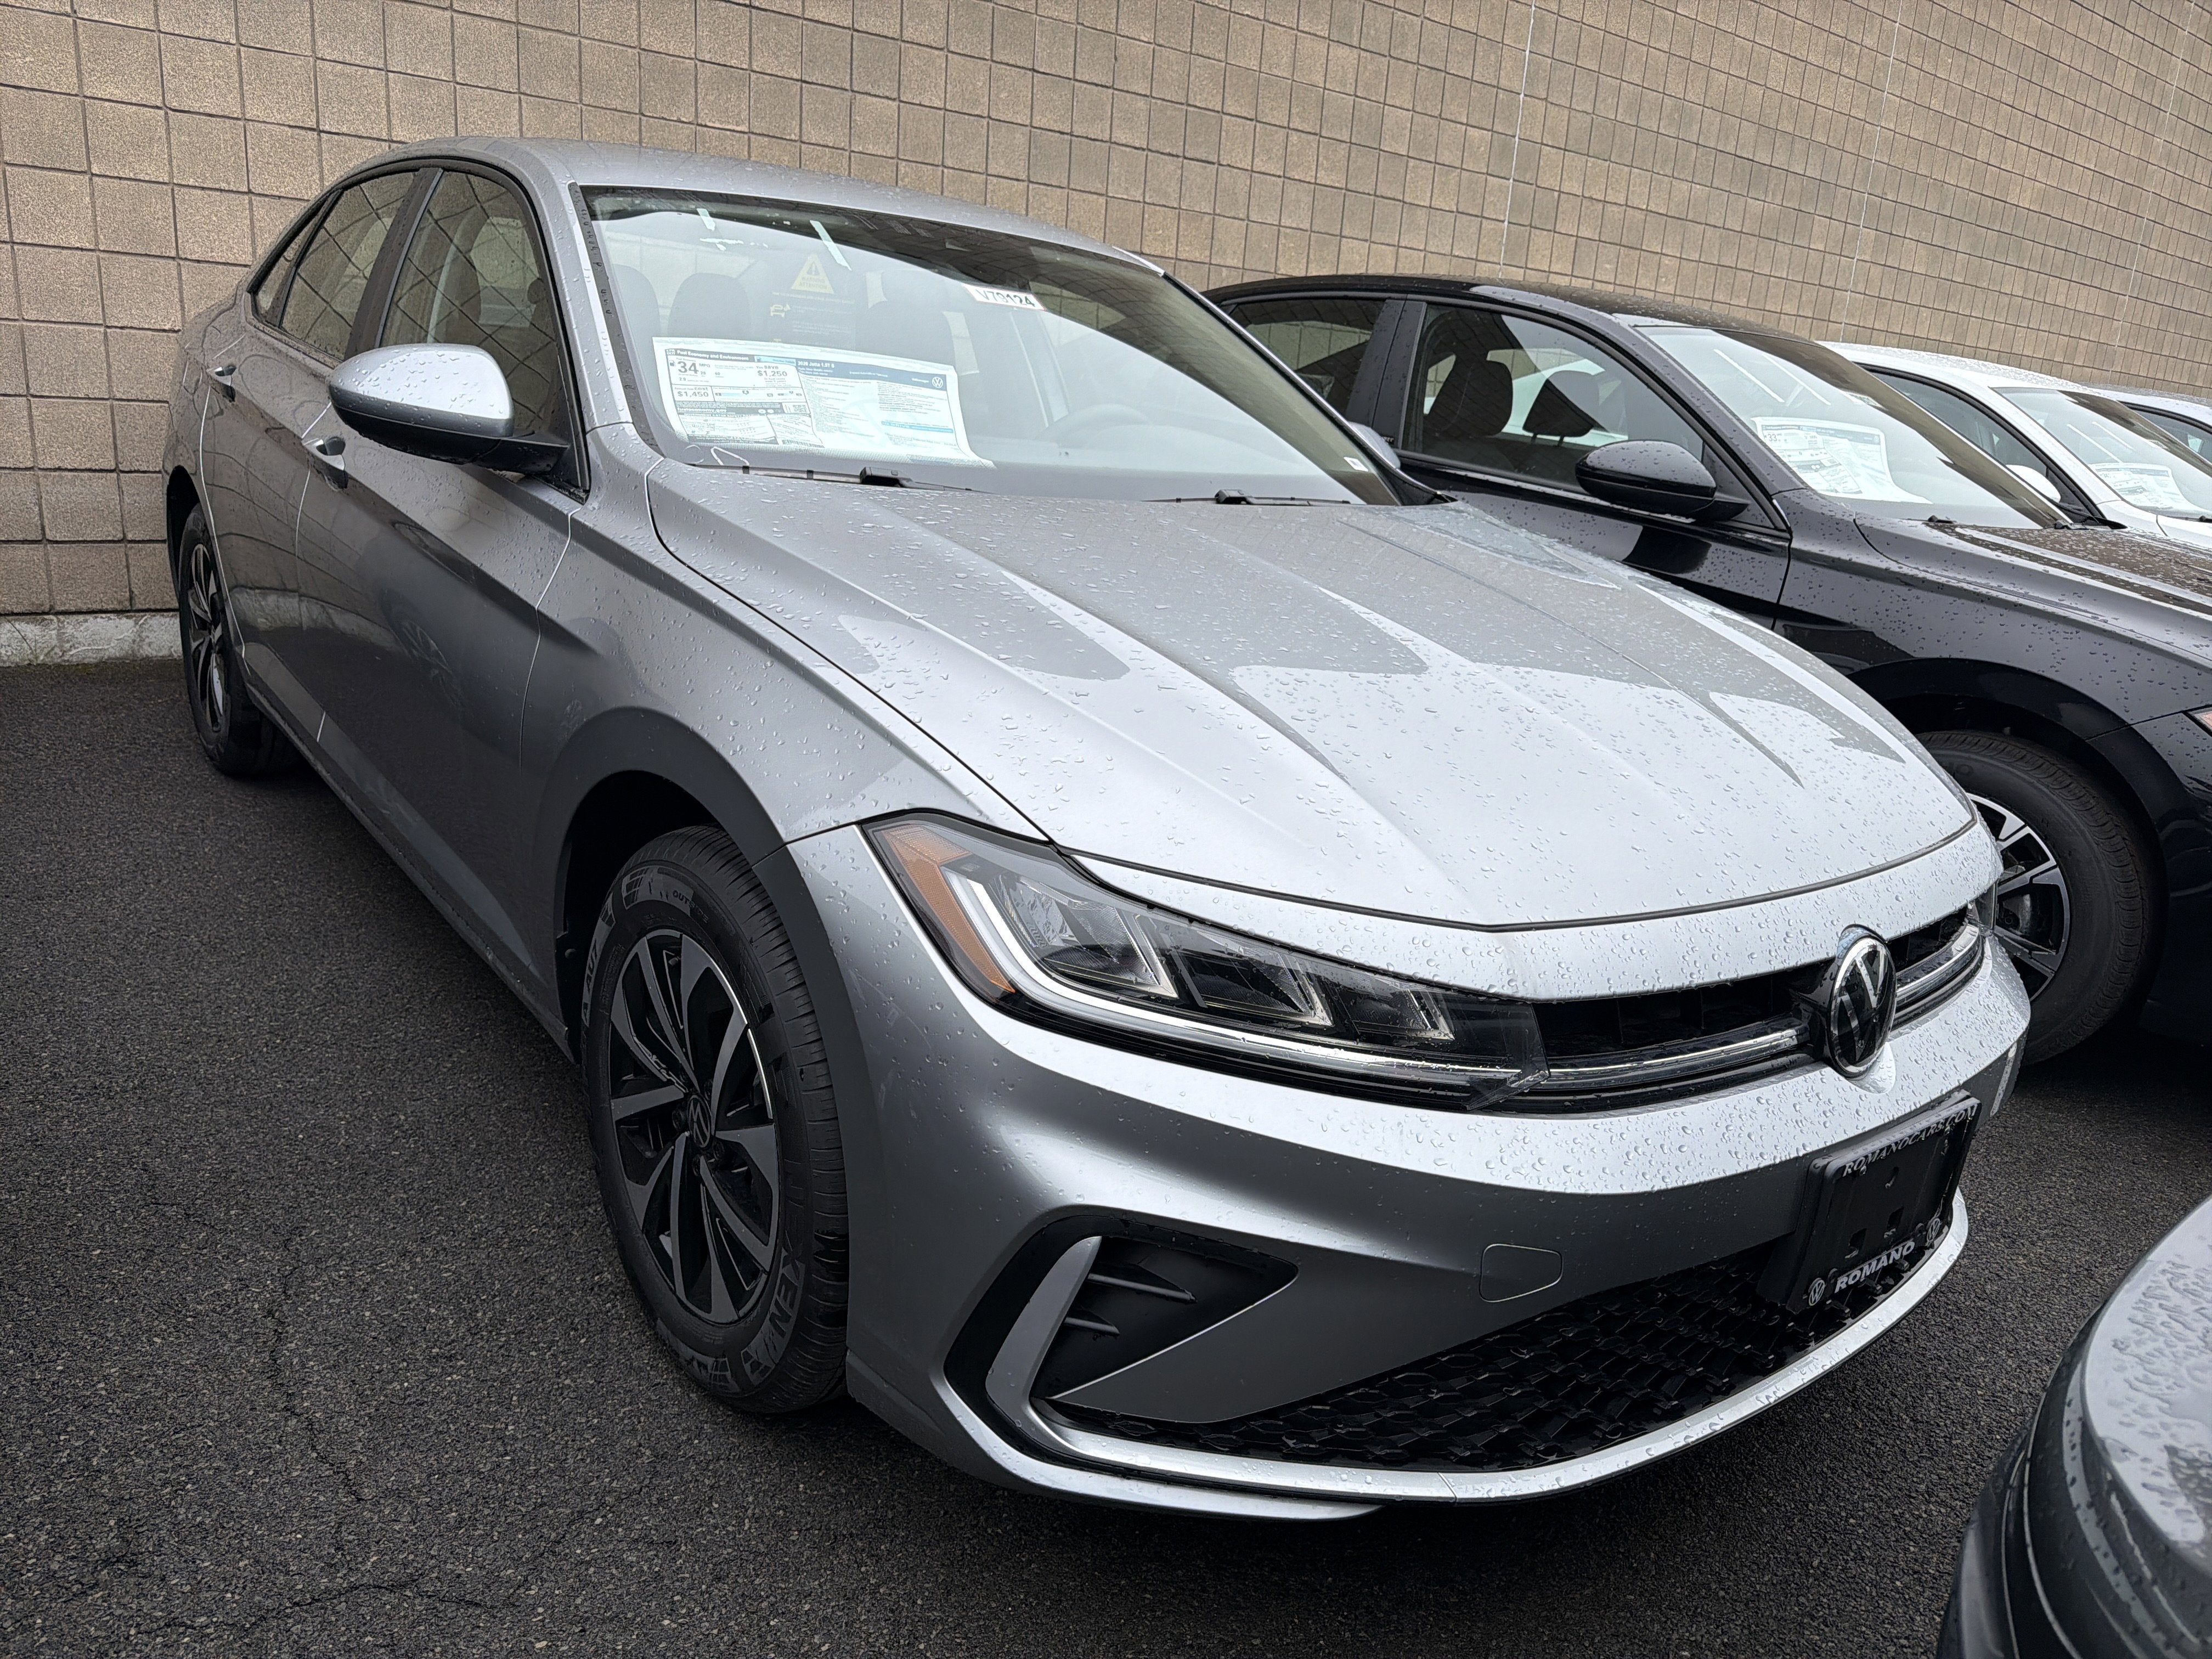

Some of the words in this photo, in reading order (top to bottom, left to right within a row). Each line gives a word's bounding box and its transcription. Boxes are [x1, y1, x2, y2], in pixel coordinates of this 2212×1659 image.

[975, 289, 1035, 308] V79124
[678, 361, 699, 374] 34
[1768, 433, 1778, 442] 33
[1841, 1105, 1978, 1177] ROMANOCARS.COM
[1834, 1241, 1915, 1294] ROMANO
